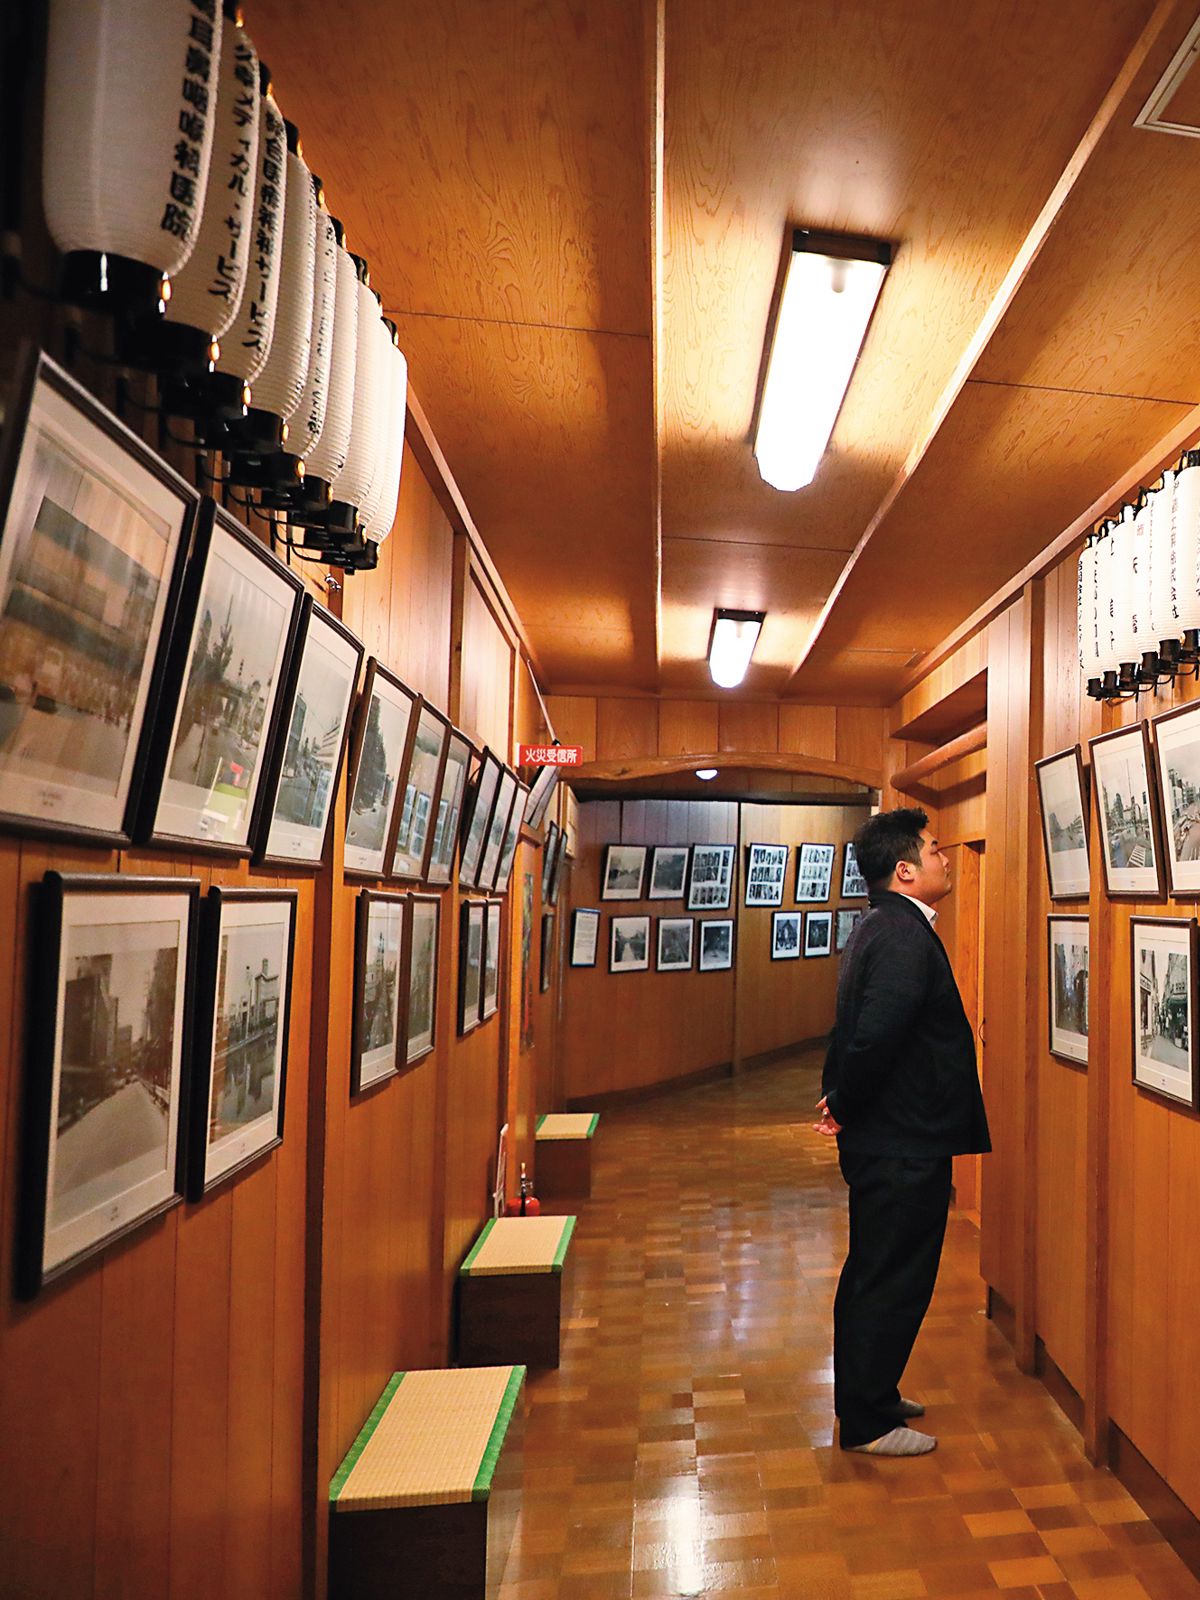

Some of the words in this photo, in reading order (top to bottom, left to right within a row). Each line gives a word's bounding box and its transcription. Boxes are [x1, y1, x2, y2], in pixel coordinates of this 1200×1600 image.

[525, 748, 578, 764] 火災受信所
